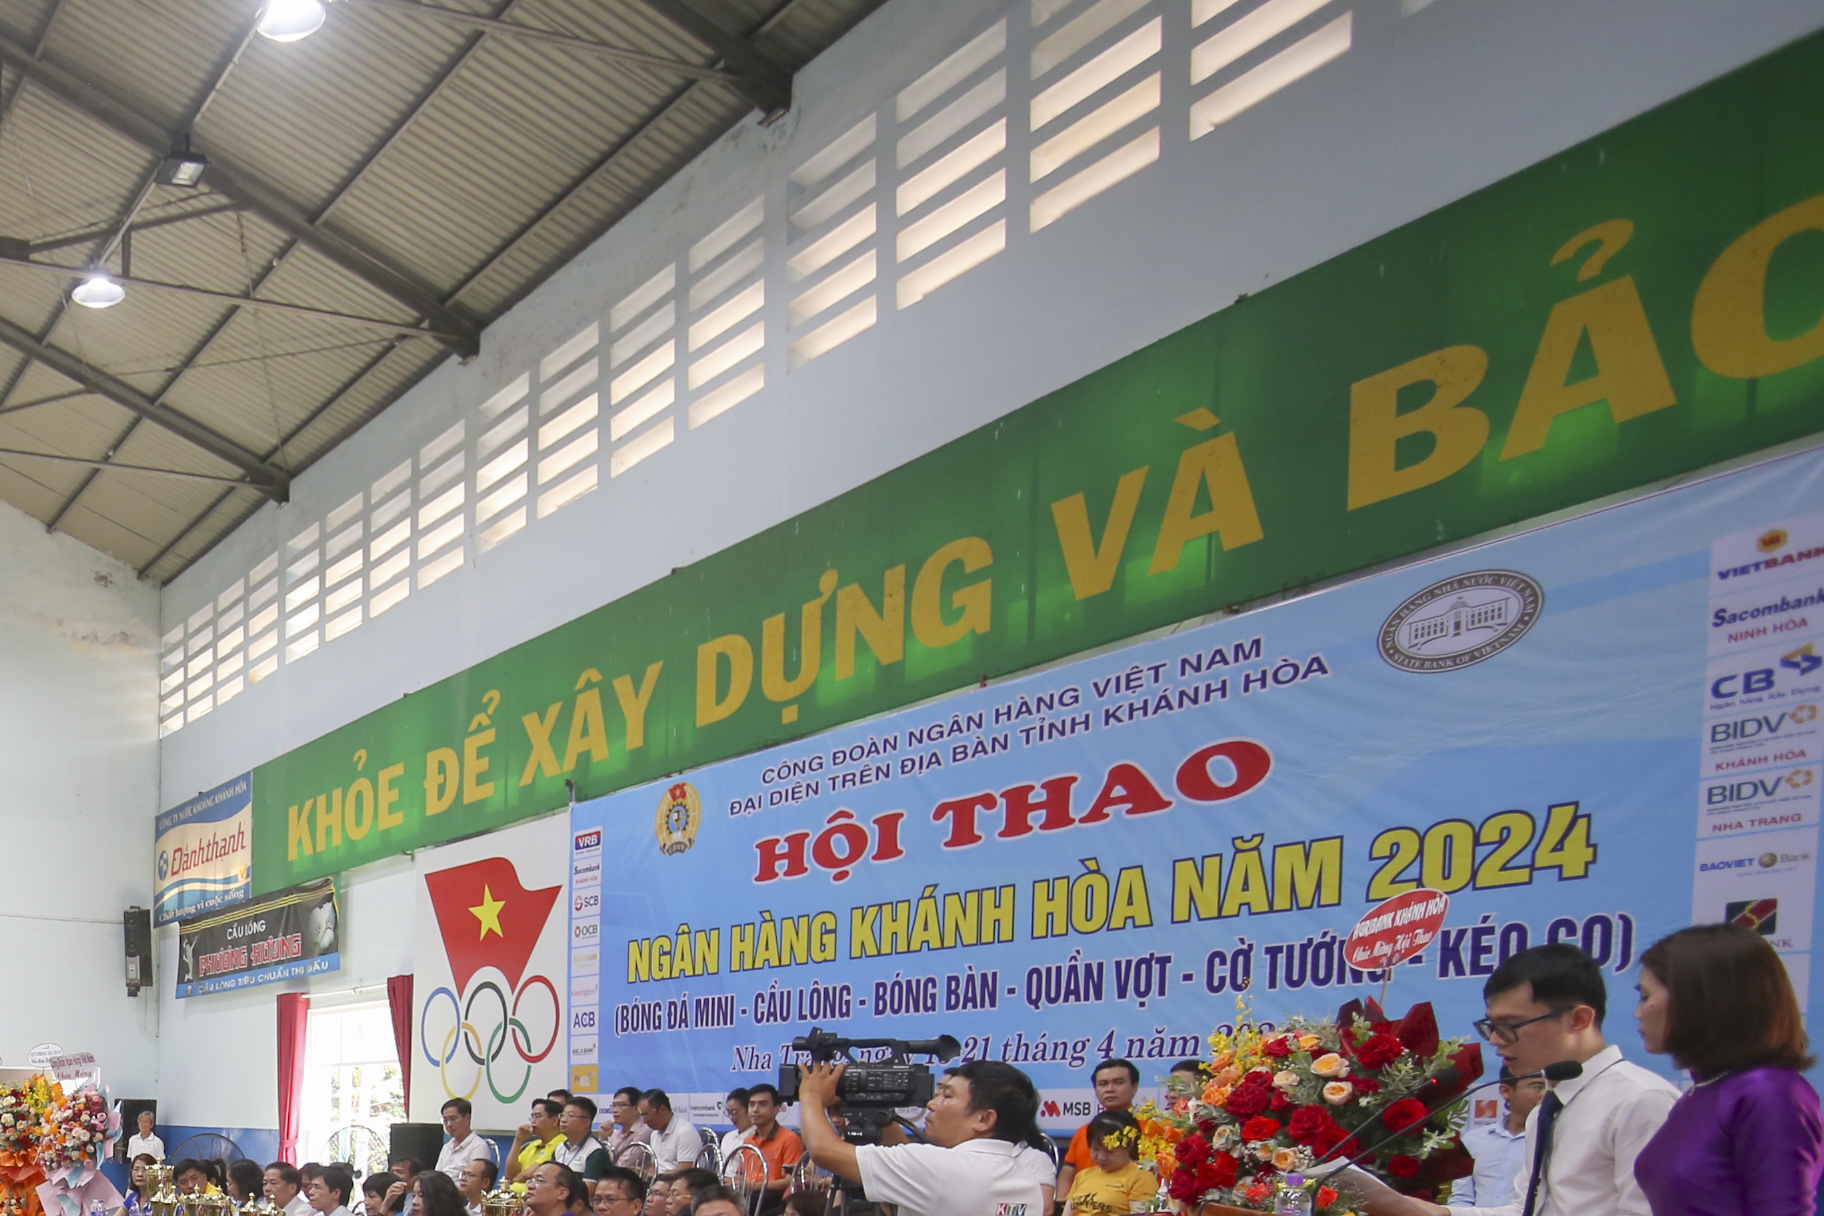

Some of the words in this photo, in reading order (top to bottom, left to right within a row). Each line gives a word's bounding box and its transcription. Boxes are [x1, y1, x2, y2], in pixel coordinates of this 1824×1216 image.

[288, 748, 404, 862] KHỎE
[424, 689, 501, 818] ĐỂ
[521, 660, 663, 787] XÂY
[695, 536, 995, 729] DỰNG
[1051, 407, 1264, 601] VÀ
[1728, 626, 1768, 643] NINH
[1773, 618, 1808, 633] HÒA
[1392, 652, 1422, 669] STATE
[1423, 658, 1456, 669] BANK
[1456, 653, 1472, 665] OF
[1472, 623, 1526, 658] VIETNAM
[1711, 668, 1775, 699] CB
[762, 755, 824, 785] CÔNG
[832, 735, 898, 766] ĐOÀN
[907, 712, 984, 746] NGÂN
[994, 687, 1080, 726] HÀNG
[1092, 662, 1167, 700] VIỆT
[1180, 637, 1262, 677] NAM
[729, 795, 762, 818] ĐẠI
[769, 780, 820, 808] DIỆN
[827, 763, 892, 792] TRÊN
[900, 750, 943, 777] ĐỊA
[951, 733, 1009, 763] BÀN
[1020, 712, 1090, 747] TỈNH
[1104, 678, 1227, 727] KHÁNH
[1242, 656, 1329, 693] HÒA
[1711, 711, 1789, 743] BIDV
[1714, 755, 1768, 771] KHÁNH
[1773, 749, 1807, 762] HÒA
[1707, 776, 1785, 805] BIDV
[753, 809, 906, 883] HỘI
[932, 741, 1271, 848] THAO
[1712, 820, 1744, 832] NHA
[1749, 813, 1803, 828] TRANG
[578, 834, 598, 849] VRB
[1699, 858, 1755, 872] BAOVIET
[584, 895, 599, 908] SCB
[627, 923, 719, 984] NGÂN
[730, 910, 837, 973] HÀNG
[849, 883, 1016, 960] KHÁNH
[1031, 857, 1152, 939] HÒA
[1172, 832, 1345, 925] NĂM
[1367, 800, 1599, 905] 2024
[1394, 901, 1427, 927] KHÁNH
[1425, 893, 1448, 919] HÒA
[227, 922, 244, 941] CẦU
[582, 924, 598, 936] OCB
[258, 965, 290, 985] CHUẨN
[291, 965, 305, 978] THI
[615, 993, 662, 1037] (BÓNG
[666, 991, 690, 1030] ĐÁ
[694, 995, 737, 1030] MINI
[753, 979, 792, 1025] CẦU
[797, 979, 852, 1022] LÔNG
[874, 970, 938, 1017] BÓNG
[945, 965, 999, 1012] BÀN
[1025, 946, 1105, 1010] QUẦN
[1114, 952, 1173, 1010] VỢT
[1205, 936, 1254, 995] CỜ
[573, 1011, 595, 1029] ACB
[732, 1047, 772, 1071] Nha
[1002, 1031, 1090, 1067] tháng
[1097, 1029, 1116, 1059] 4
[1127, 1027, 1200, 1059] năm
[1063, 1102, 1091, 1116] MSB
[996, 1203, 1028, 1216] KTV
